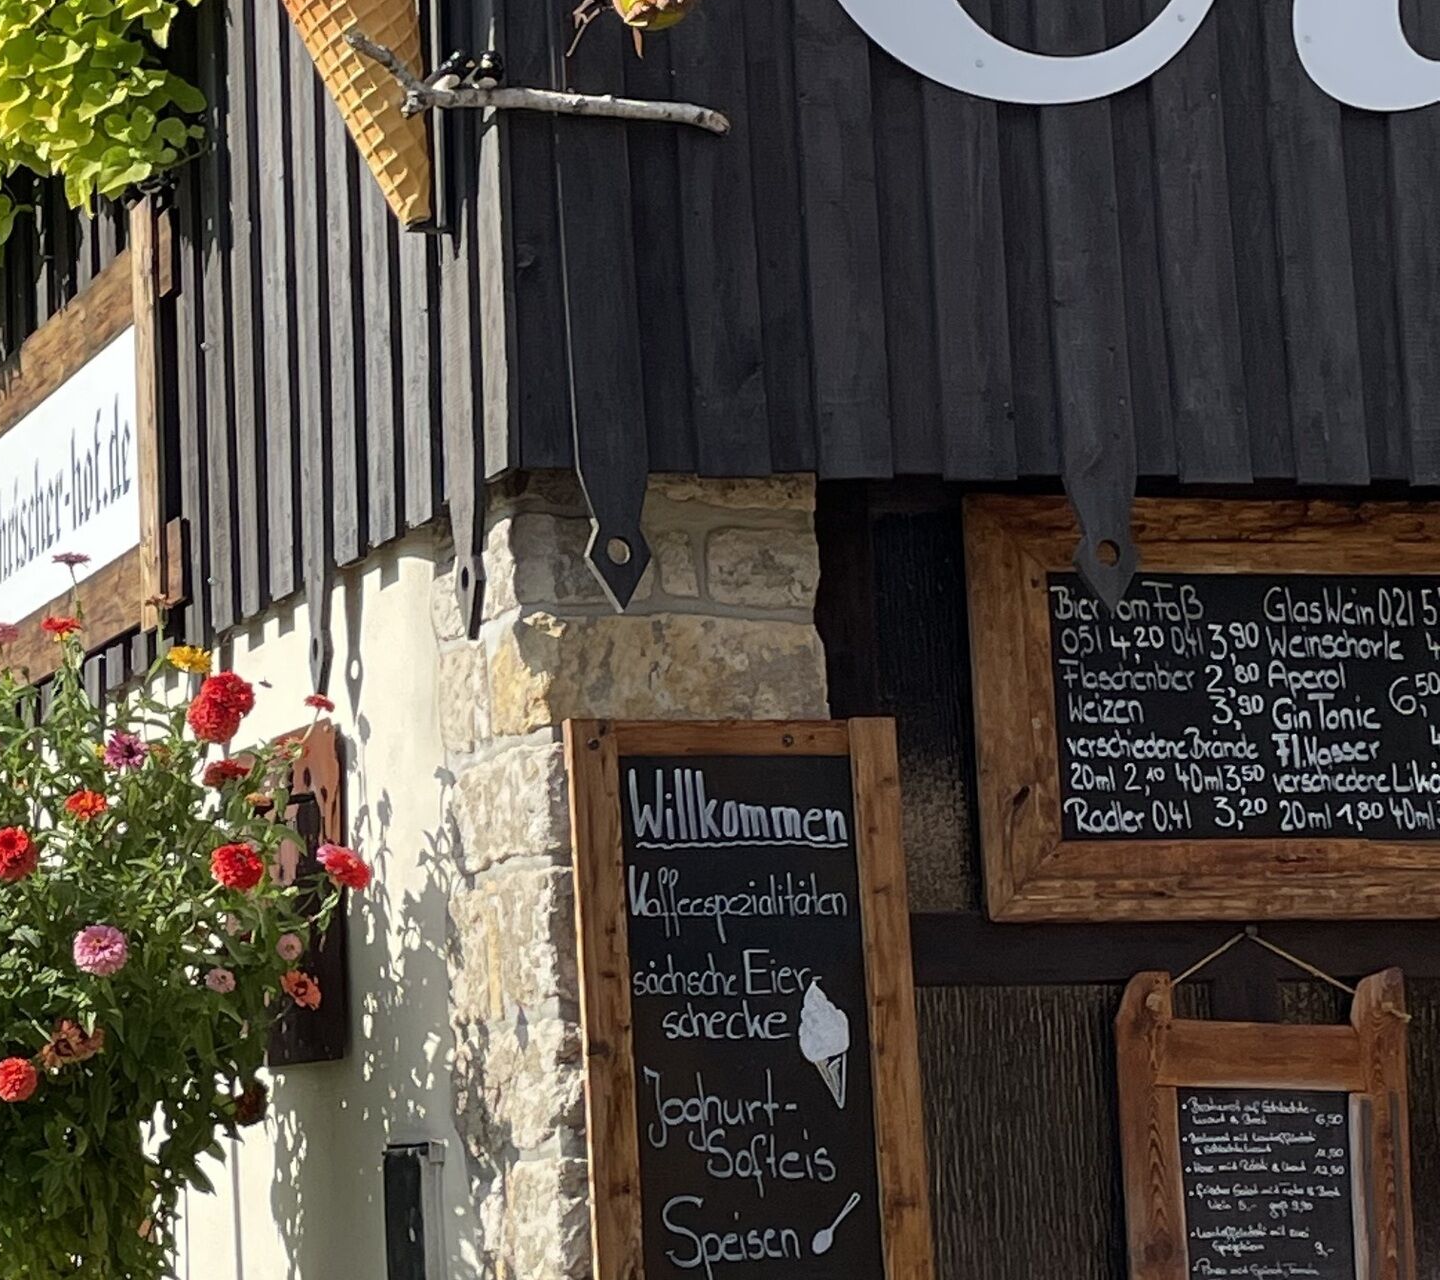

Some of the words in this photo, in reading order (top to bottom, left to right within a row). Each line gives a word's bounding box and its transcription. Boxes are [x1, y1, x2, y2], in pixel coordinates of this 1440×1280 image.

[1049, 585, 1100, 621] Bier
[1208, 621, 1260, 666] 3,90
[1265, 624, 1405, 661] Weinschorle
[1058, 658, 1196, 692] Flaschenbier
[1267, 659, 1347, 700] Aperol
[1068, 692, 1145, 724] Weizen
[1209, 694, 1265, 731] 3,90
[1272, 696, 1312, 732] Gin
[1307, 692, 1382, 732] Tonic
[1066, 728, 1189, 760] verschiedene
[1183, 726, 1260, 760] Brände
[1070, 761, 1116, 792] 20ml
[1174, 762, 1224, 794] 40ml
[1271, 763, 1392, 794] verschiedene
[628, 767, 849, 842] Willkommen
[1063, 797, 1146, 834] Radler
[1212, 795, 1269, 831] 3,20
[1278, 799, 1332, 832] 20ml
[1388, 796, 1436, 830] 40ml
[628, 864, 849, 944] Kaffeespezialitäten
[662, 998, 793, 1040] schecke
[642, 1065, 798, 1150] Joghurt-
[706, 1127, 837, 1198] Softeis
